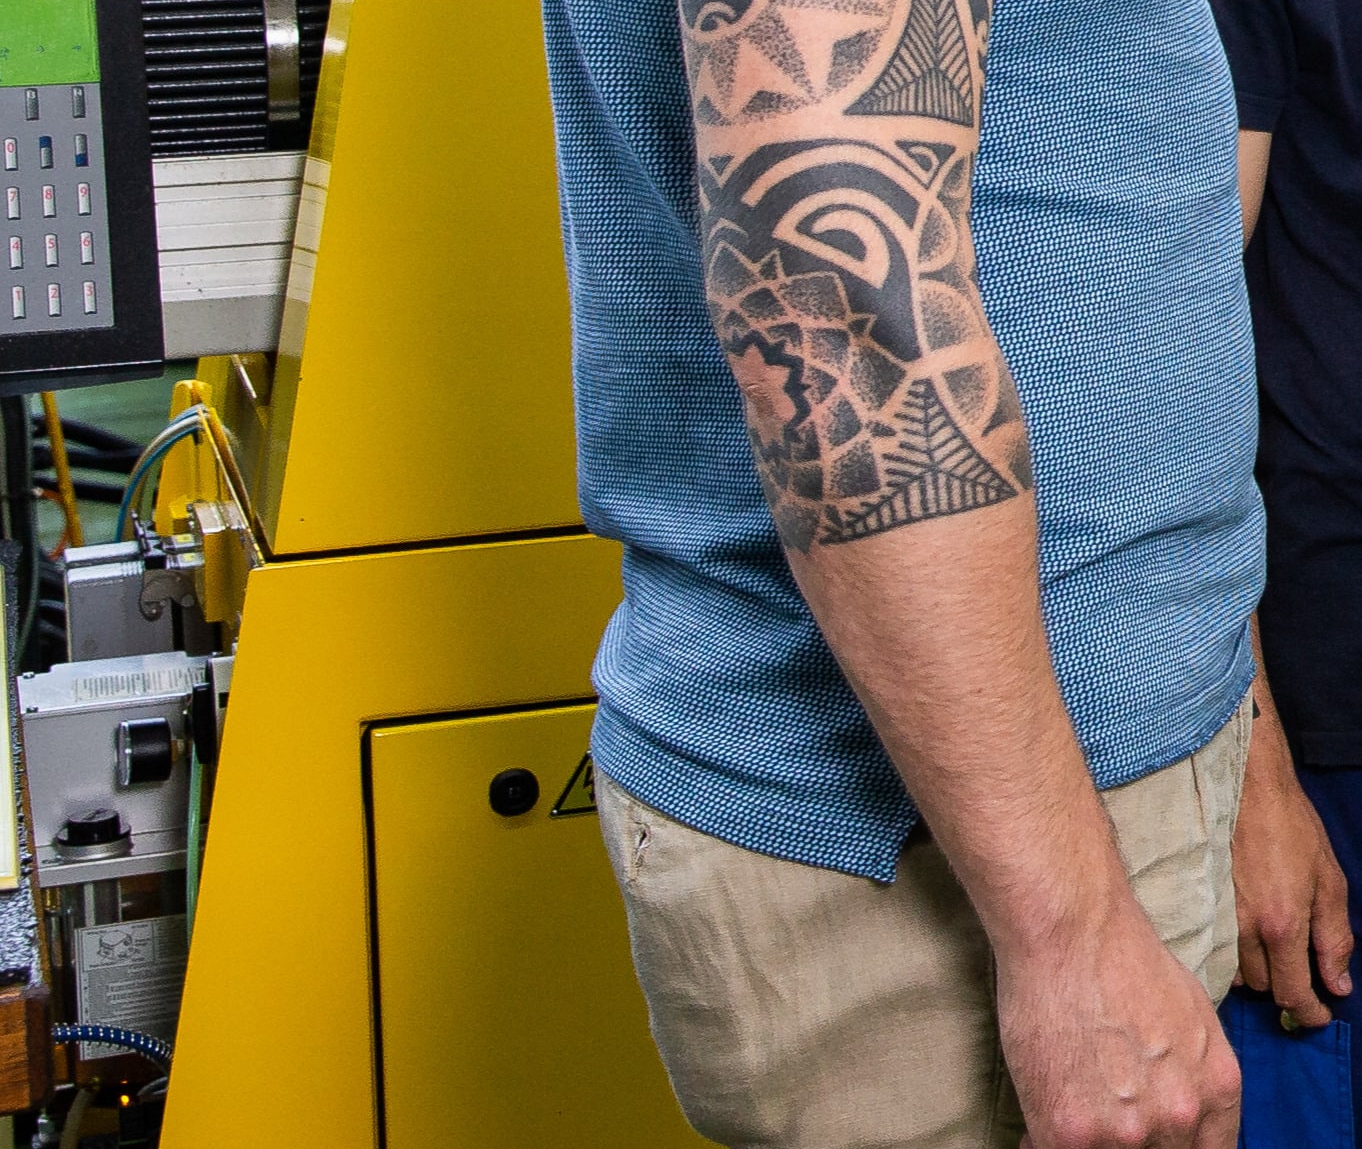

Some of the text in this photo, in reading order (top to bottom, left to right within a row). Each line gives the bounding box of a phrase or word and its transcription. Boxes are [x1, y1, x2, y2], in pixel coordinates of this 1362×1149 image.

[6, 142, 14, 153] 0
[10, 186, 87, 202] 7 8 9
[12, 235, 90, 250] 4 5 6
[15, 285, 93, 301] 1 2 3
